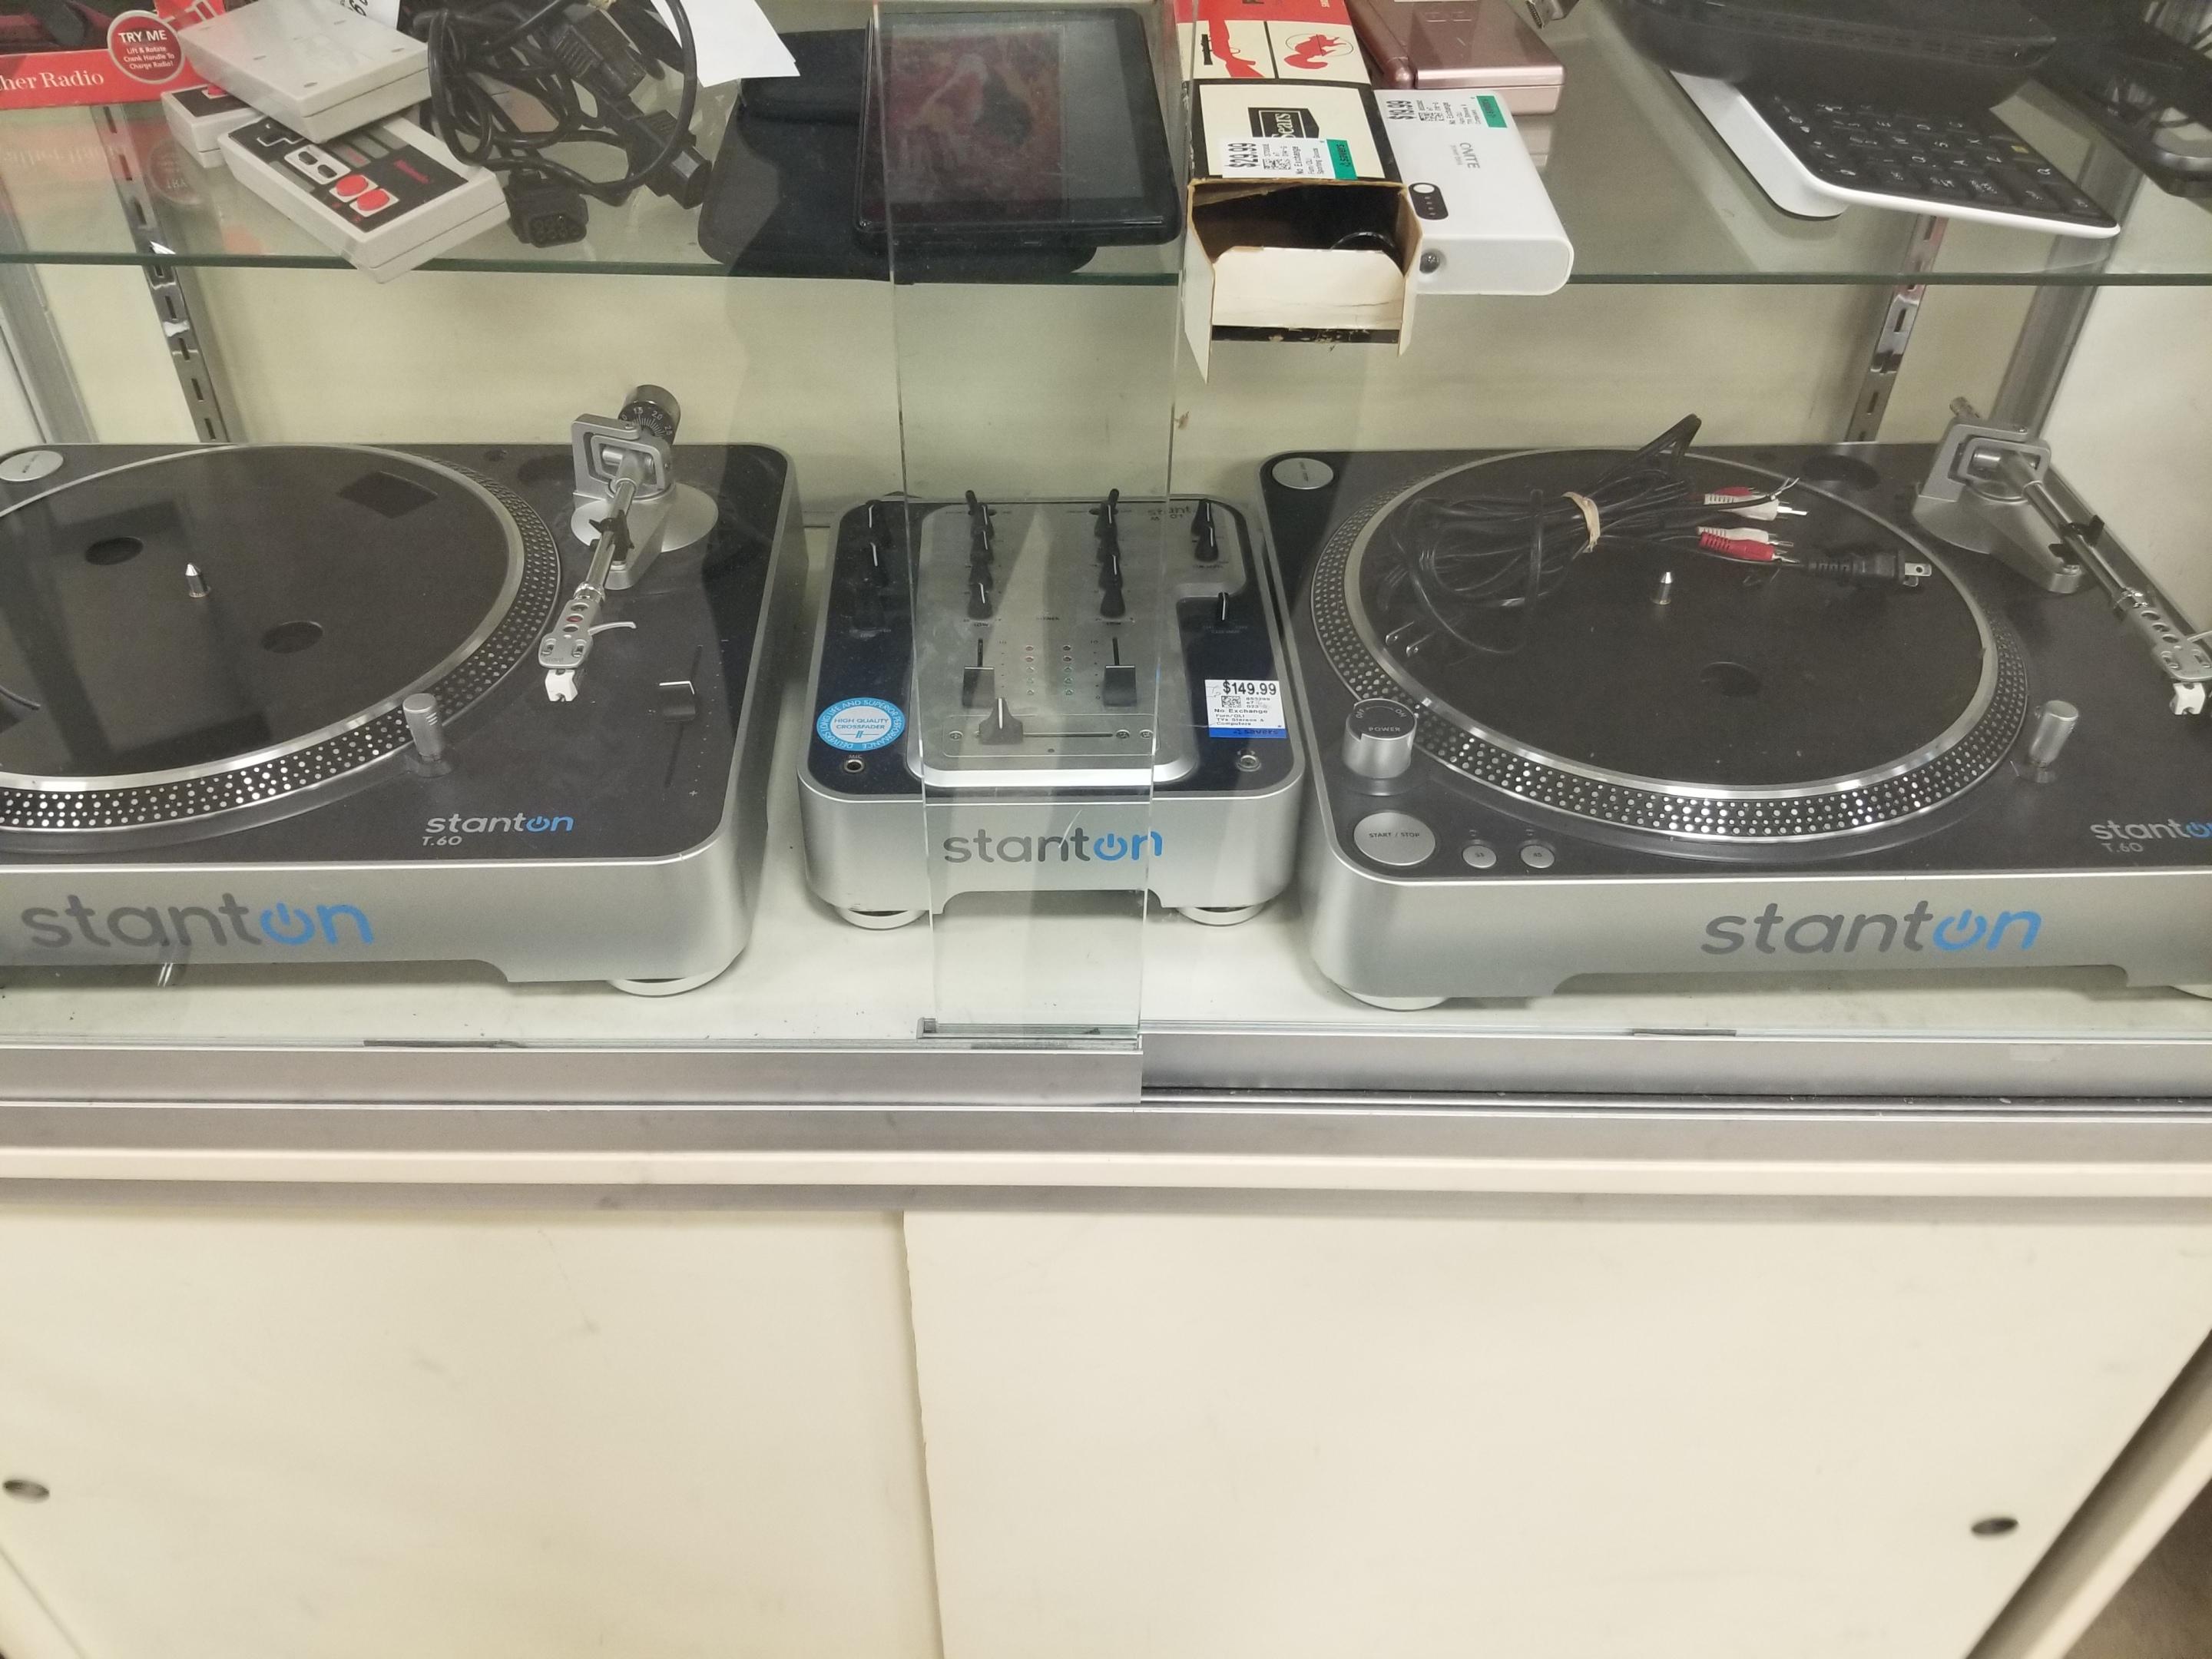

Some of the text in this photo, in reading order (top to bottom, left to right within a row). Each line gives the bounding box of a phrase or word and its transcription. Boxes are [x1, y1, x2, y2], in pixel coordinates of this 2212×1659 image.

[118, 29, 167, 43] TRY ME
[0, 70, 104, 91] her Radio
[1386, 100, 1416, 121] $19.99
[1224, 142, 1261, 168] $29.99
[1459, 142, 1481, 168] ONITE
[1223, 679, 1277, 695] $149.99
[842, 700, 861, 709] AND
[1395, 708, 1407, 717] ON
[425, 813, 574, 833] stanton
[2090, 818, 2212, 840] stanto
[422, 835, 462, 846] T.60
[943, 826, 1163, 863] stanton
[21, 892, 375, 950] stanton
[1700, 899, 2042, 955] stanton
